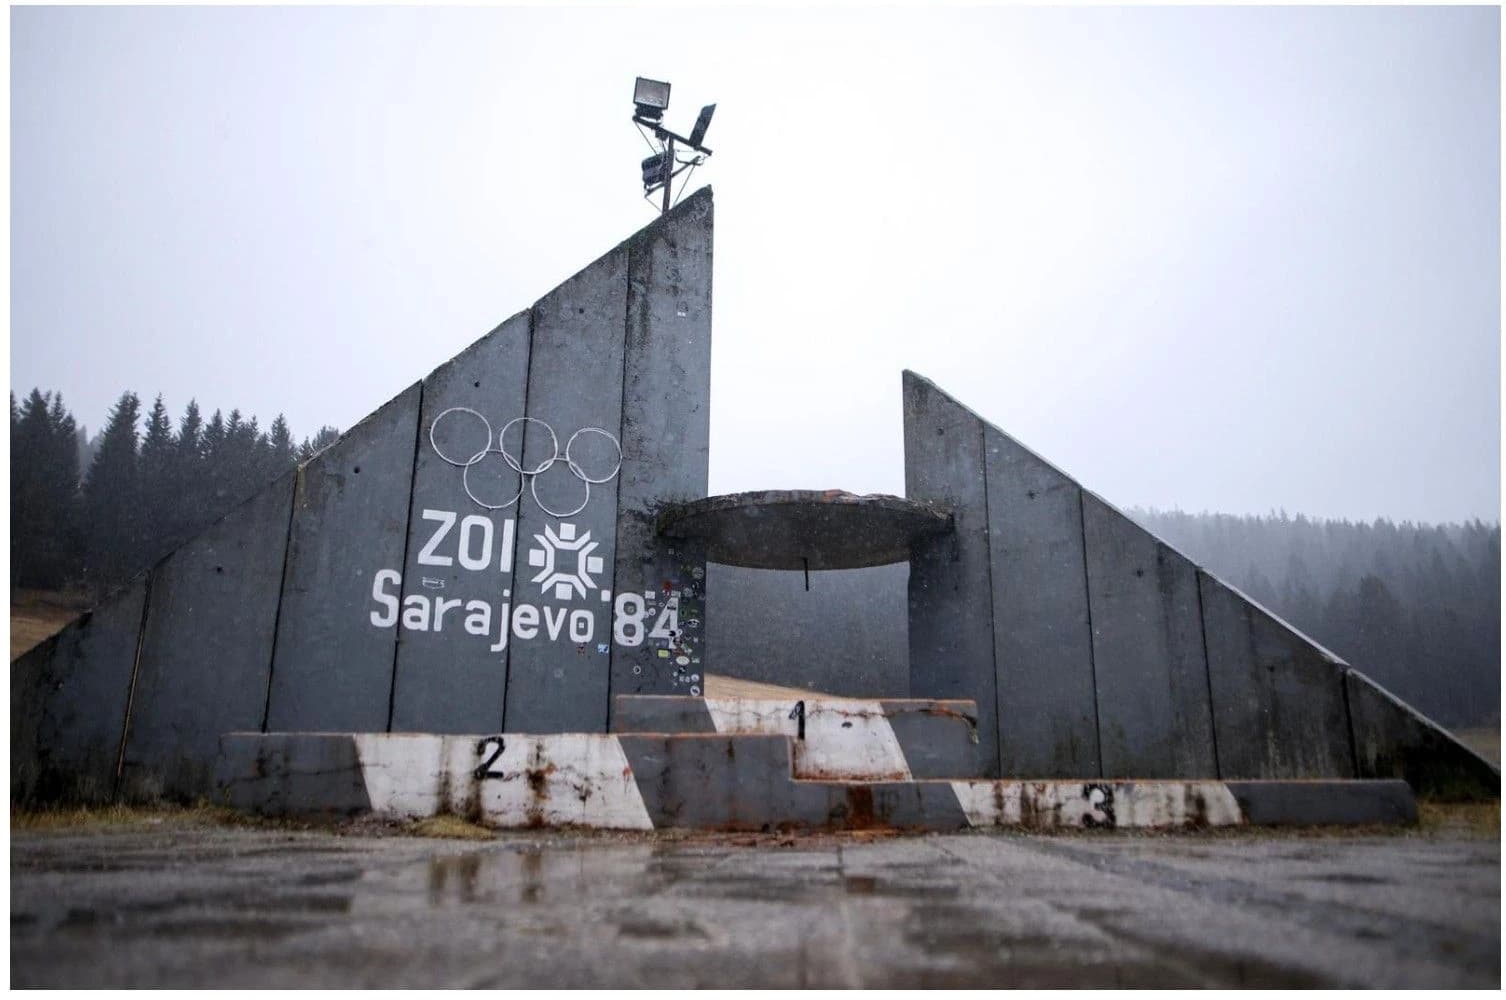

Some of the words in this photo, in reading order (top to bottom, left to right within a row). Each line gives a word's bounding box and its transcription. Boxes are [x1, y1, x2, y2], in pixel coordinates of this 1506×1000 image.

[417, 508, 515, 573] ZOI
[370, 568, 595, 652] Sarajevo
[788, 700, 806, 740] 1
[473, 736, 506, 779] 2
[1081, 783, 1115, 829] 3
